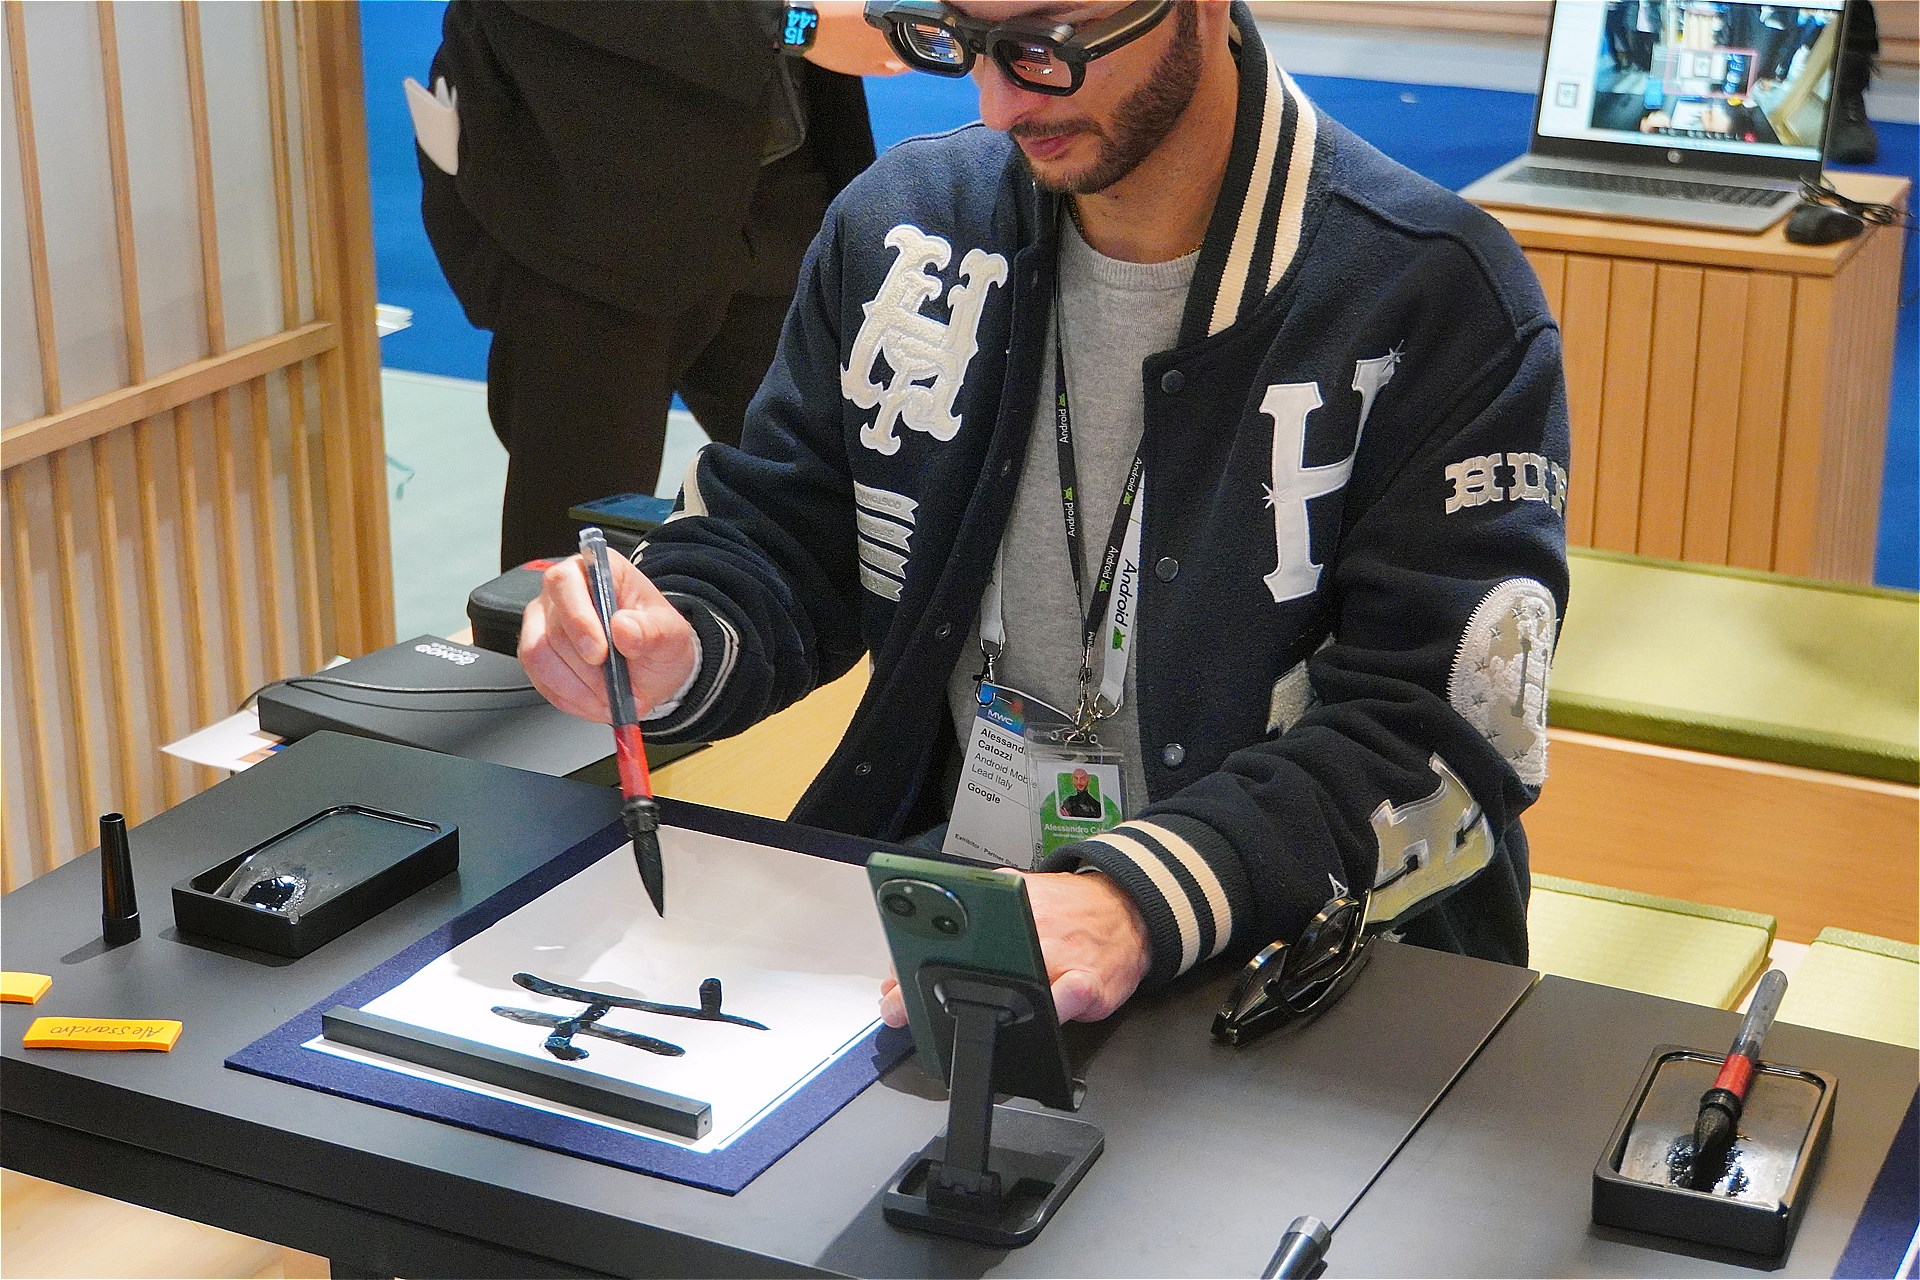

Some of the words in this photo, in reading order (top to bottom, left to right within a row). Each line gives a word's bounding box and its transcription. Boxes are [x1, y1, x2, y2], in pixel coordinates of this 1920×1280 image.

[784, 28, 805, 45] 15
[1058, 408, 1069, 443] Android
[1127, 457, 1142, 492] Android
[1064, 502, 1076, 538] Android
[1102, 545, 1119, 580] Android
[1114, 558, 1138, 628] Android
[987, 709, 1013, 726] MWC
[978, 739, 1013, 762] Catozzi
[980, 728, 1026, 755] Alessand
[971, 763, 994, 780] Lead
[995, 774, 1013, 791] Italy
[975, 752, 1008, 774] Android
[1009, 768, 1038, 789] Mobe
[967, 782, 1001, 804] Google
[1044, 823, 1089, 834] Alessandro
[984, 847, 1005, 863] Partner
[50, 1025, 164, 1040] Alessandro
